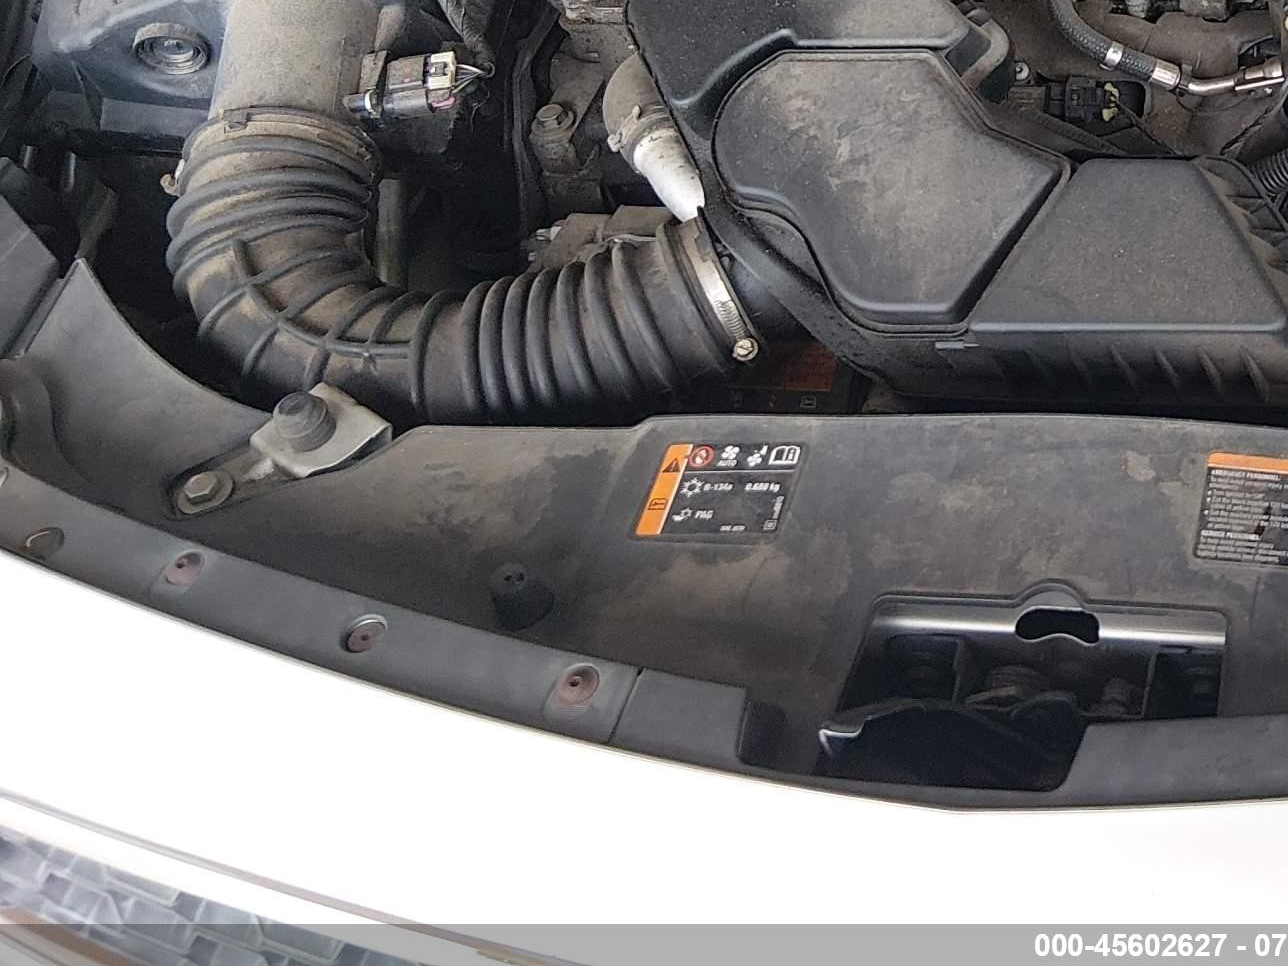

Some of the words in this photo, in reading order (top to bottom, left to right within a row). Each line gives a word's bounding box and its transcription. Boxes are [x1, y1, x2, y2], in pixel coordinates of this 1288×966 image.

[717, 459, 737, 467] AUTO
[703, 483, 733, 491] R-134a
[769, 482, 780, 492] kg
[694, 510, 714, 520] PAG
